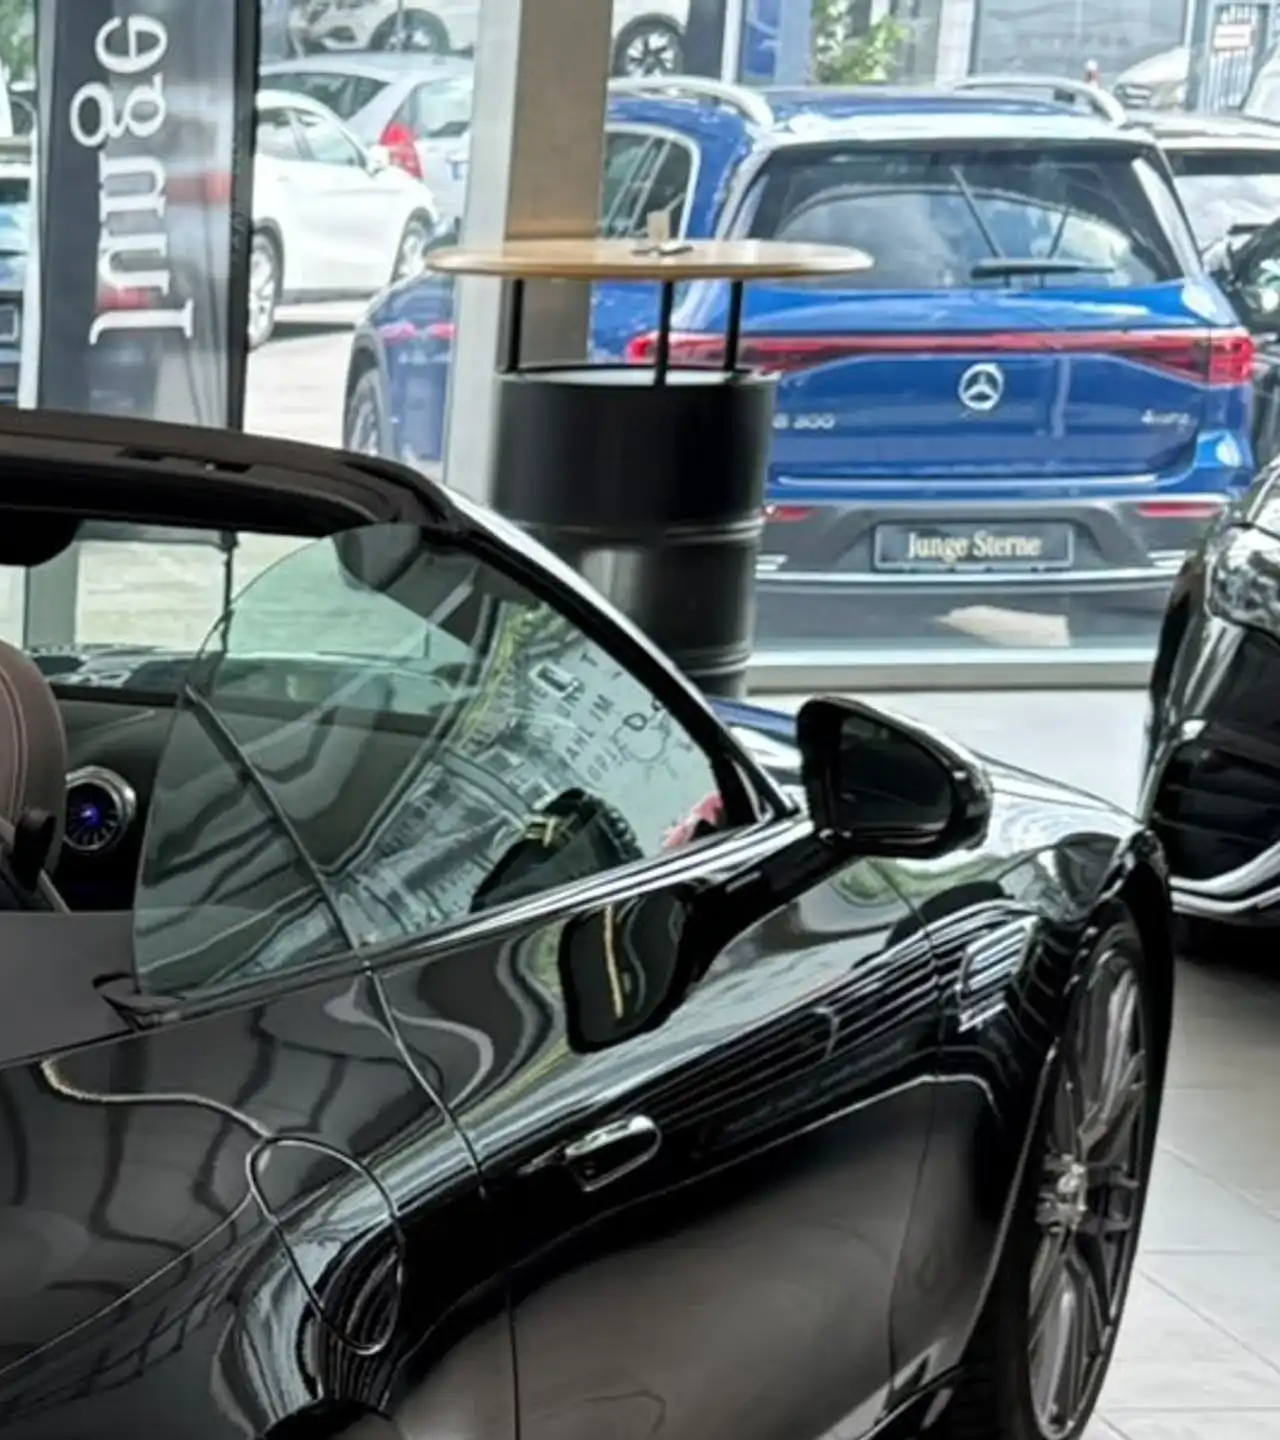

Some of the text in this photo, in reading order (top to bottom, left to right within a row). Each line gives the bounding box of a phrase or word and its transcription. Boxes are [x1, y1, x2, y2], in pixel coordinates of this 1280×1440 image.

[67, 13, 195, 346] Junge
[907, 529, 1043, 564] Junge Sterne
